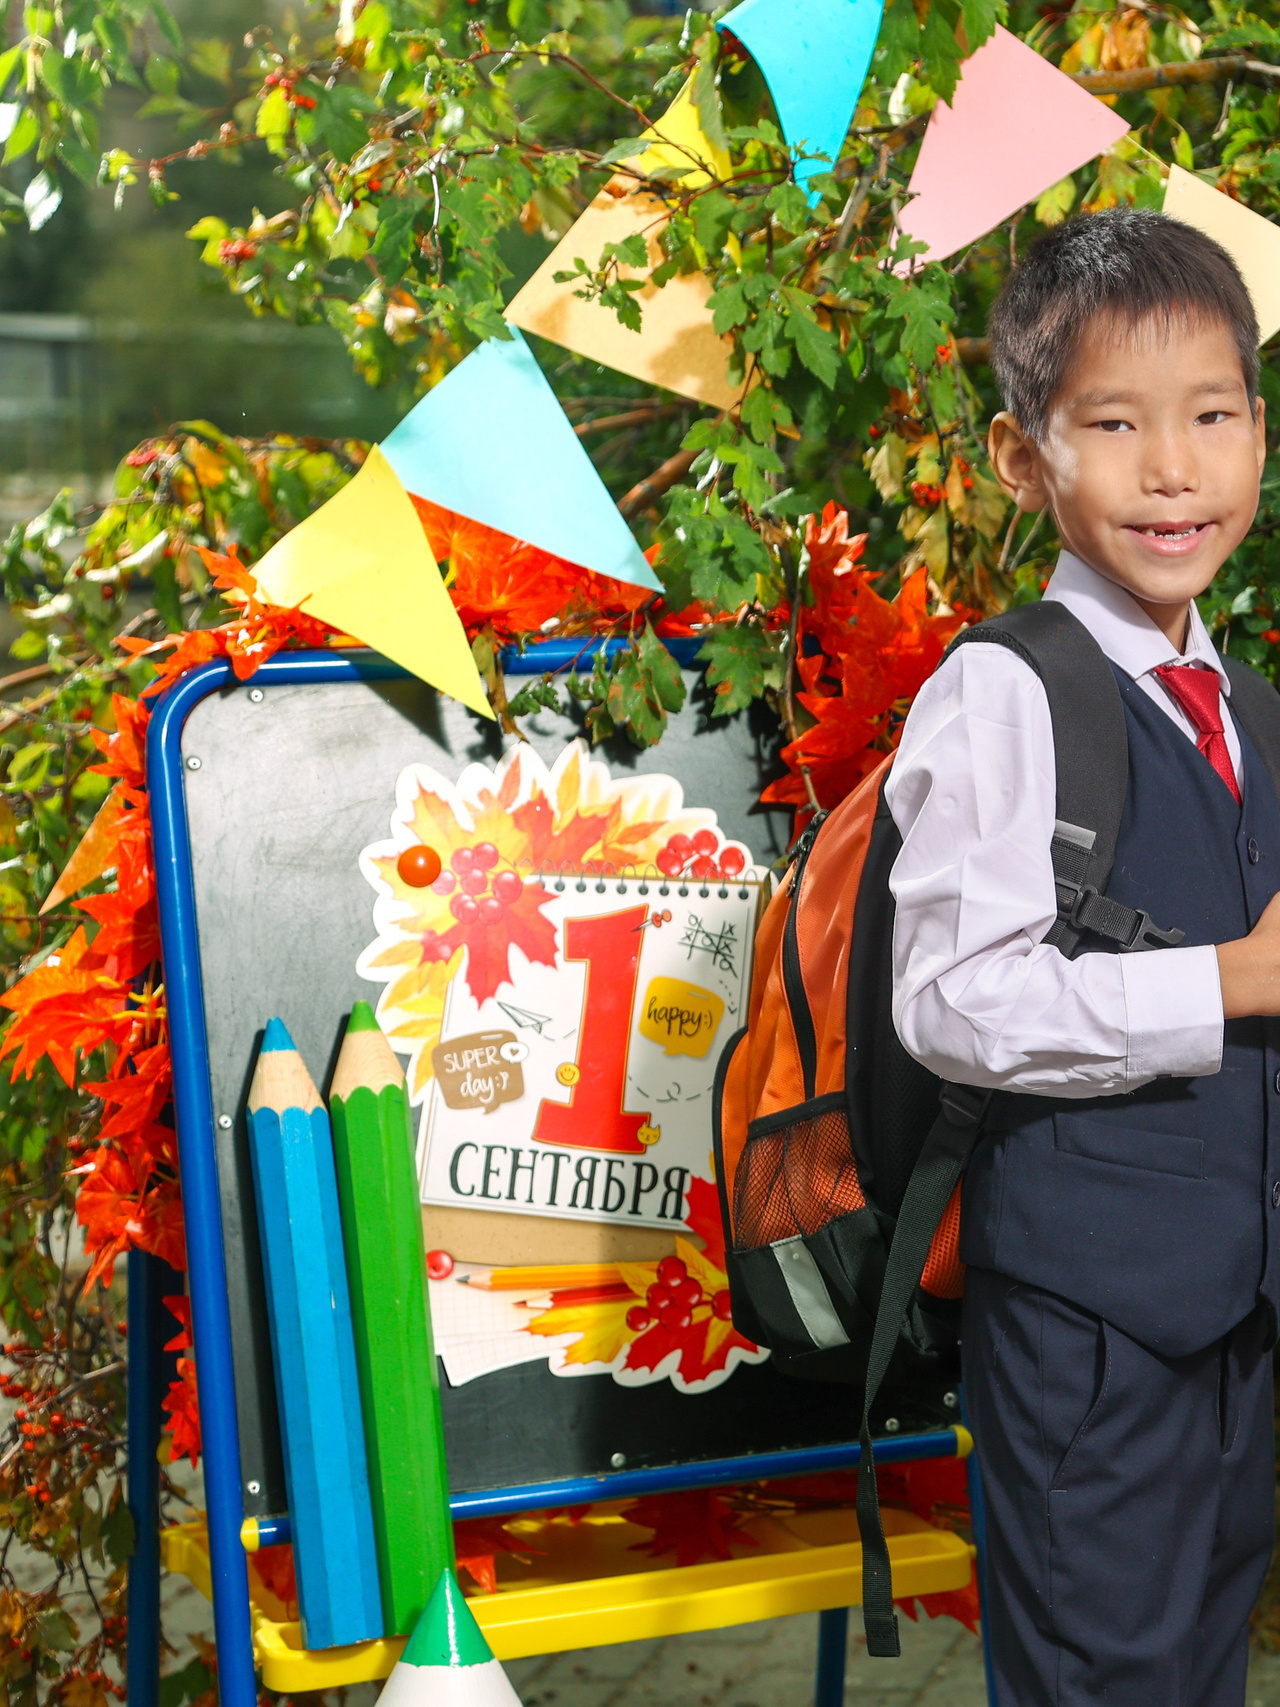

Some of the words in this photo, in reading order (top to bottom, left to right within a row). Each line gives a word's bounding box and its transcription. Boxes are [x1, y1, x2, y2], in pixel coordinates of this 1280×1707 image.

[443, 1045, 501, 1073] SUPER
[532, 903, 651, 1154] 1
[449, 1141, 690, 1221] СЕНТЯБРЯ
